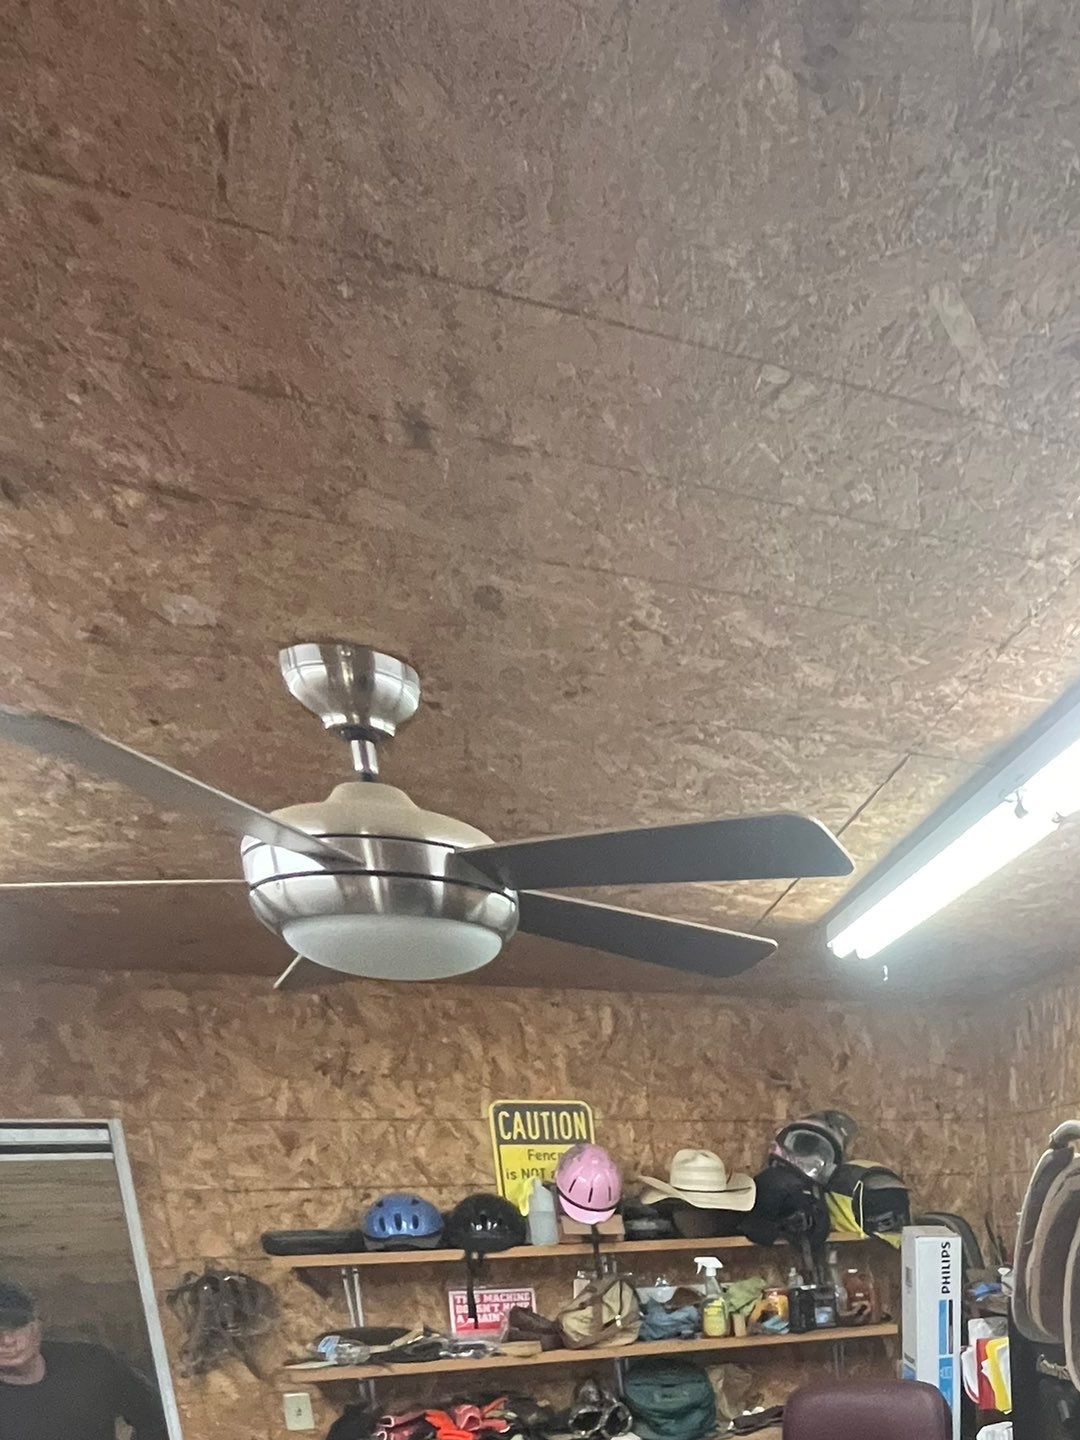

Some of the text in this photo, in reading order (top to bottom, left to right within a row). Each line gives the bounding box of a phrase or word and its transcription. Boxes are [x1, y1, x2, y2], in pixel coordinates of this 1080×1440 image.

[498, 1111, 587, 1140] CAUTION
[506, 1169, 517, 1180] is
[521, 1168, 546, 1180] NOT
[941, 1241, 952, 1294] PHILIPS
[483, 1292, 531, 1303] MACHINE
